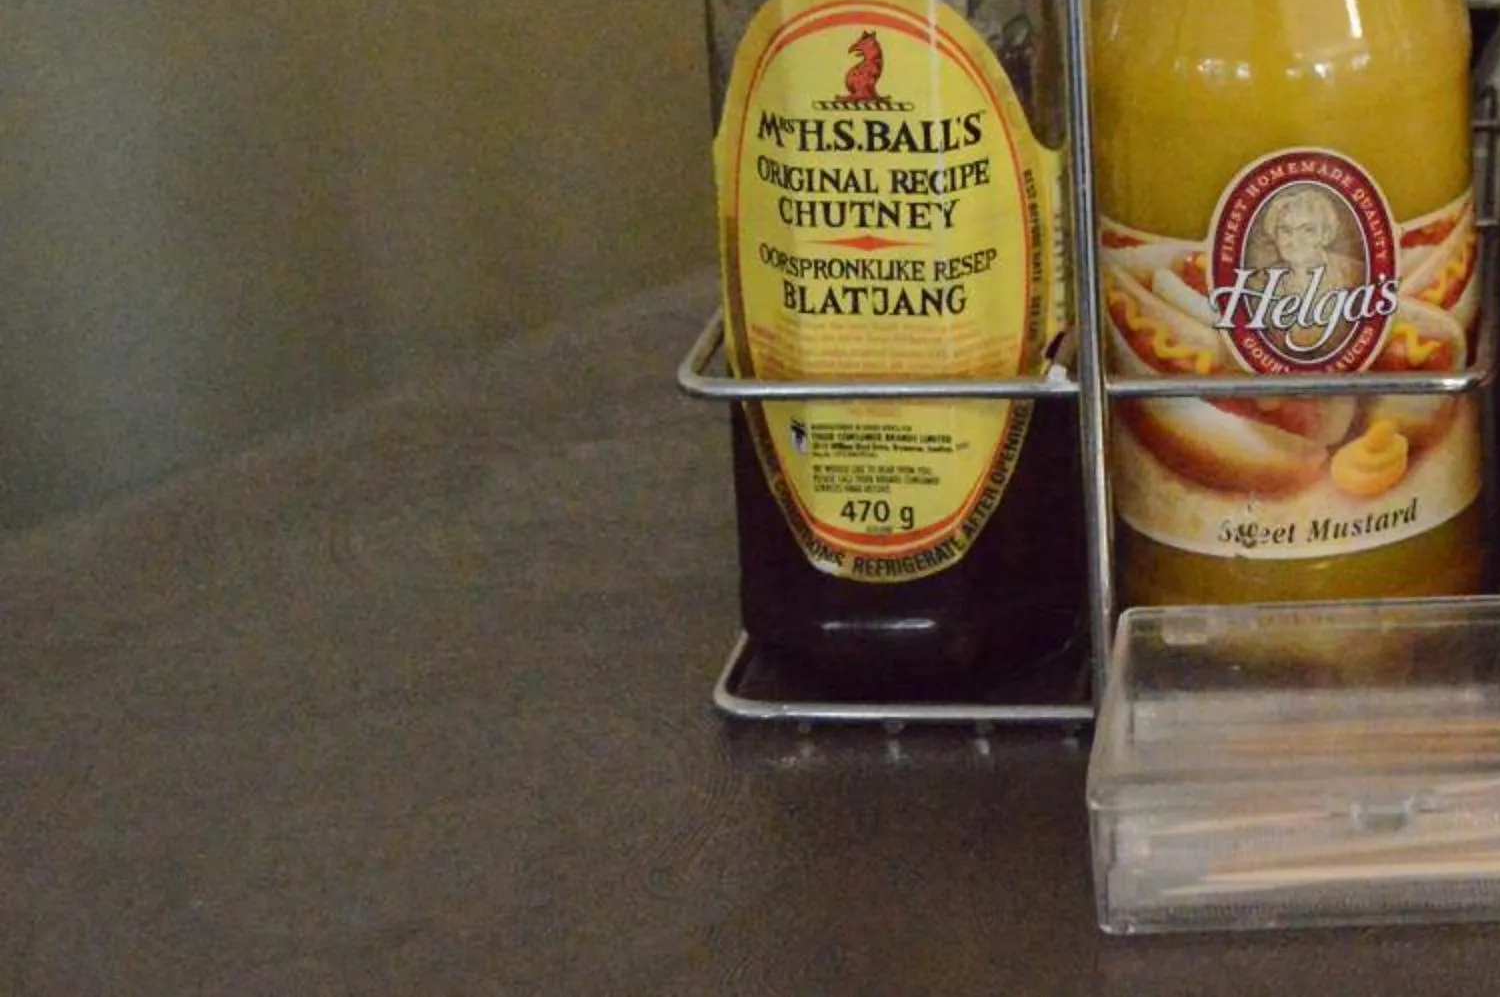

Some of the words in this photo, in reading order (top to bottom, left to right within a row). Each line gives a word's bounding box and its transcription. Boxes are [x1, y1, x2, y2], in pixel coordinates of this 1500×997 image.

[757, 155, 879, 194] ORIGINAL
[889, 159, 990, 195] RECIPE
[778, 199, 960, 230] CHUTNEY
[1221, 201, 1248, 263] FINEST
[1245, 160, 1353, 197] HOMEMADE
[1352, 188, 1388, 260] QUALITY
[759, 243, 924, 281] OORSPRONKLIKE
[934, 248, 997, 282] RESEP
[784, 281, 967, 316] BLATJANG
[1209, 266, 1401, 353] Helga's
[852, 534, 968, 577] REFRIGERATE
[962, 491, 999, 537] AFTER
[992, 404, 1030, 486] OPENING
[841, 499, 890, 523] 470
[899, 505, 915, 530] g
[1306, 497, 1419, 542] Mustard
